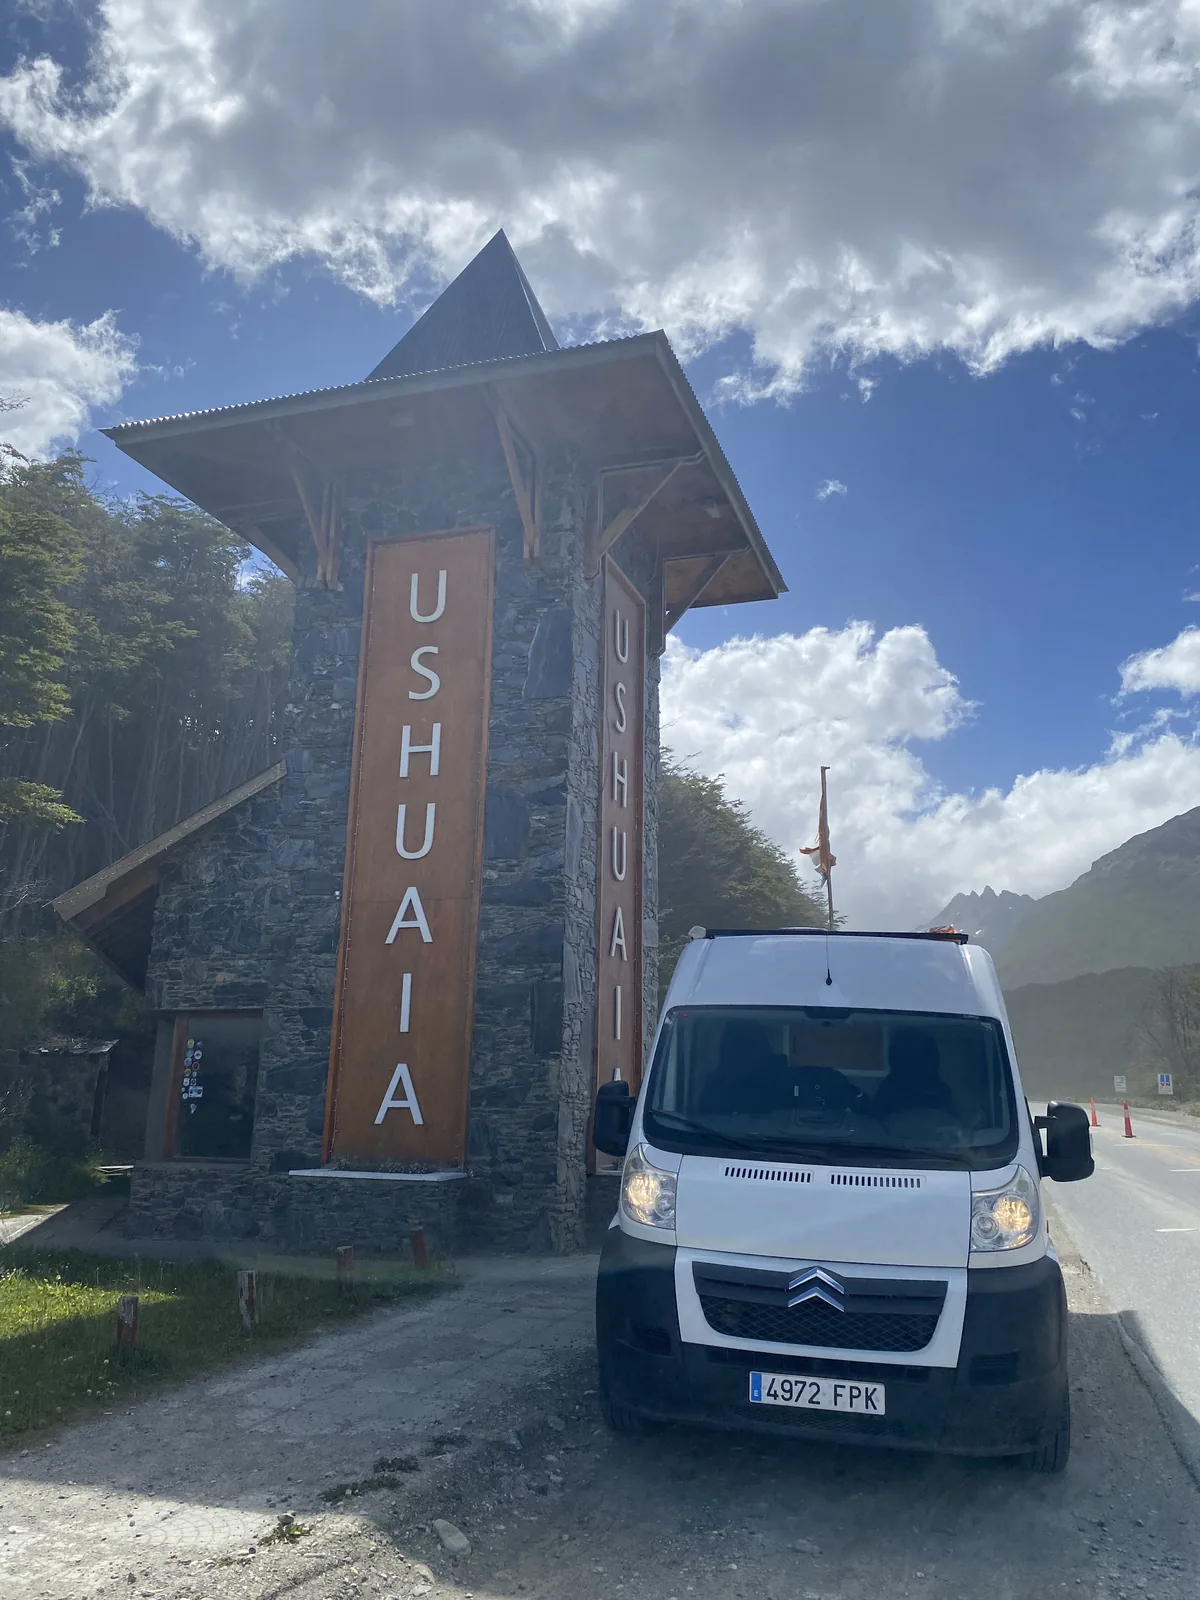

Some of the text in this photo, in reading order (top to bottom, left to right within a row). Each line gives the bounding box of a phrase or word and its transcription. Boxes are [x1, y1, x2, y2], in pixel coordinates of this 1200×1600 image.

[374, 569, 448, 1125] USHUAIA
[610, 609, 629, 1081] USHUAI
[766, 1377, 821, 1405] 4972
[833, 1384, 878, 1411] FPK
